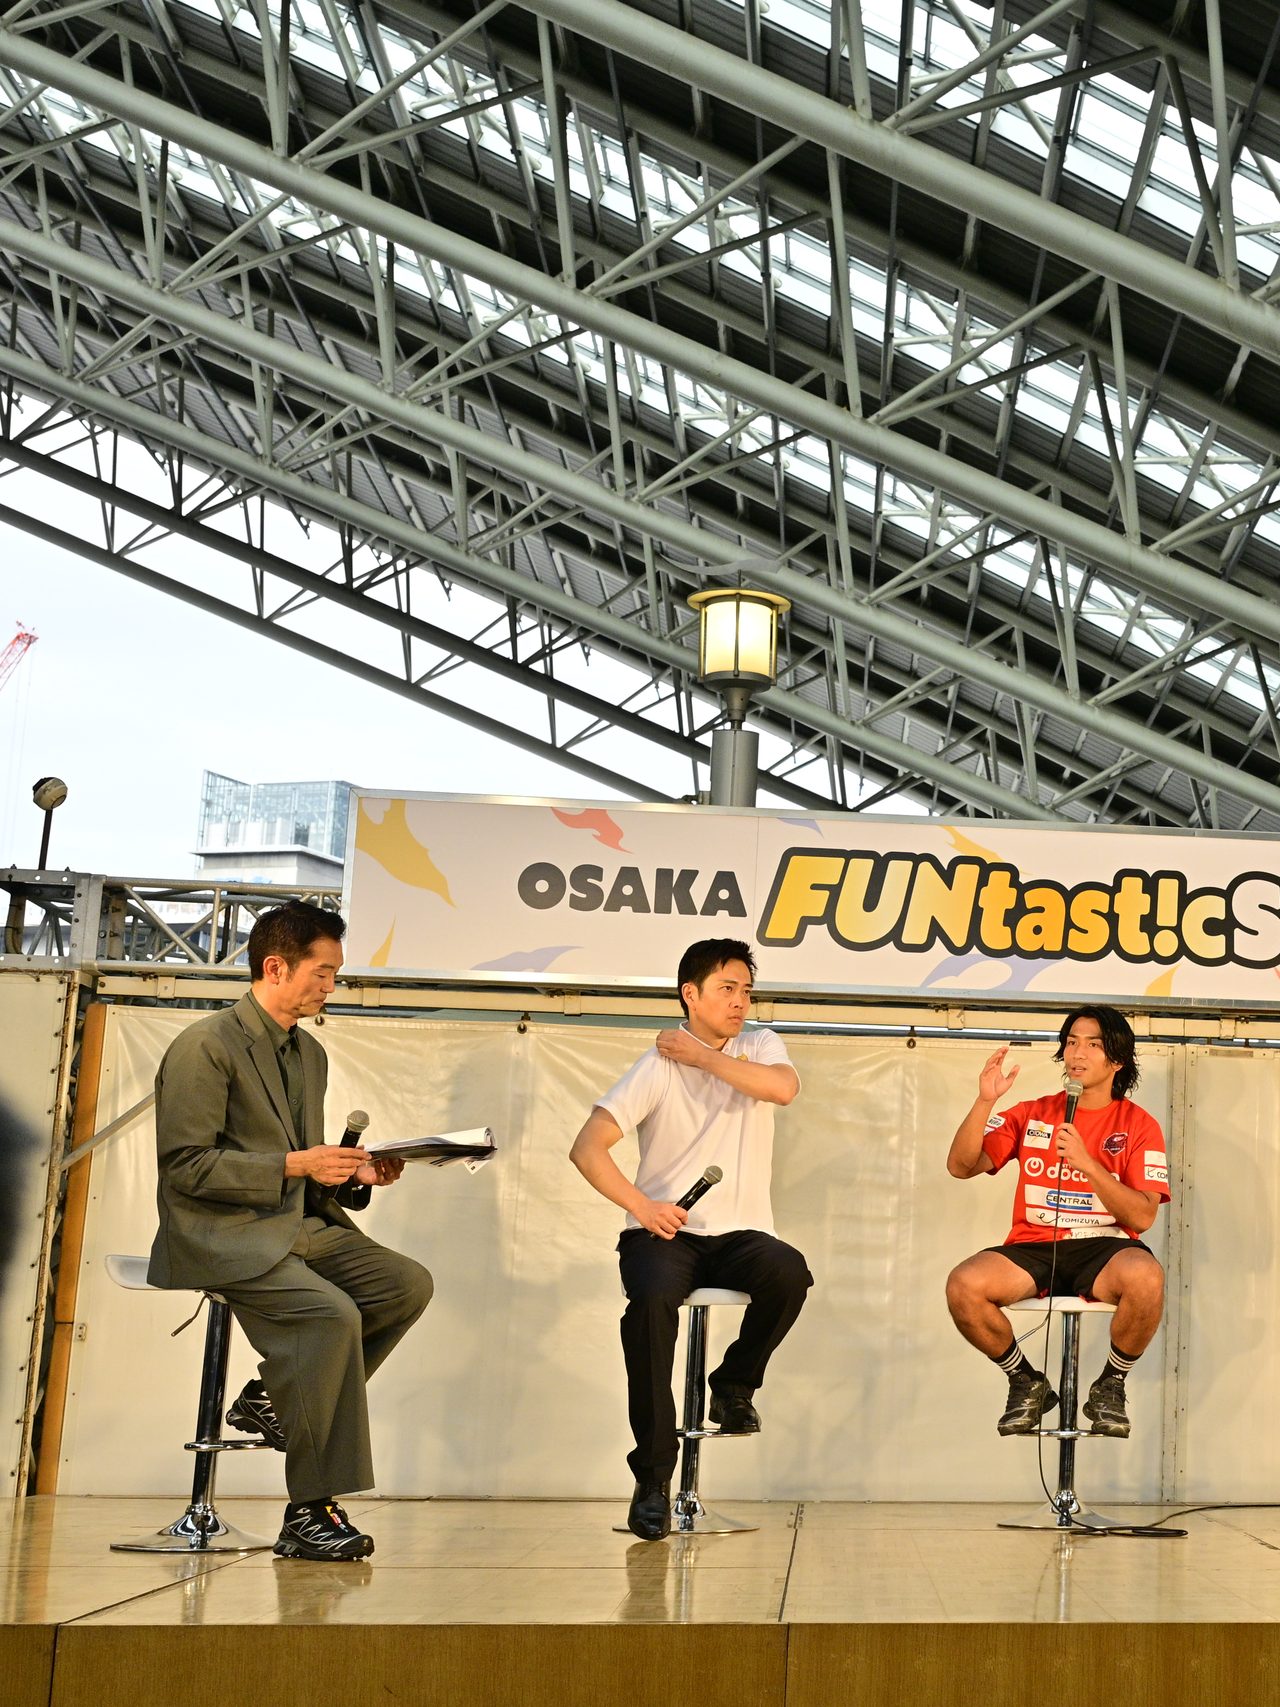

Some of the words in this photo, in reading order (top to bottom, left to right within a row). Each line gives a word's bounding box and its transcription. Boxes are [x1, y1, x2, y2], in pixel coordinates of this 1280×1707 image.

[518, 862, 748, 917] OSAKA
[1046, 1194, 1093, 1206] CENTRAL
[1061, 1217, 1100, 1225] TOMIZUYA
